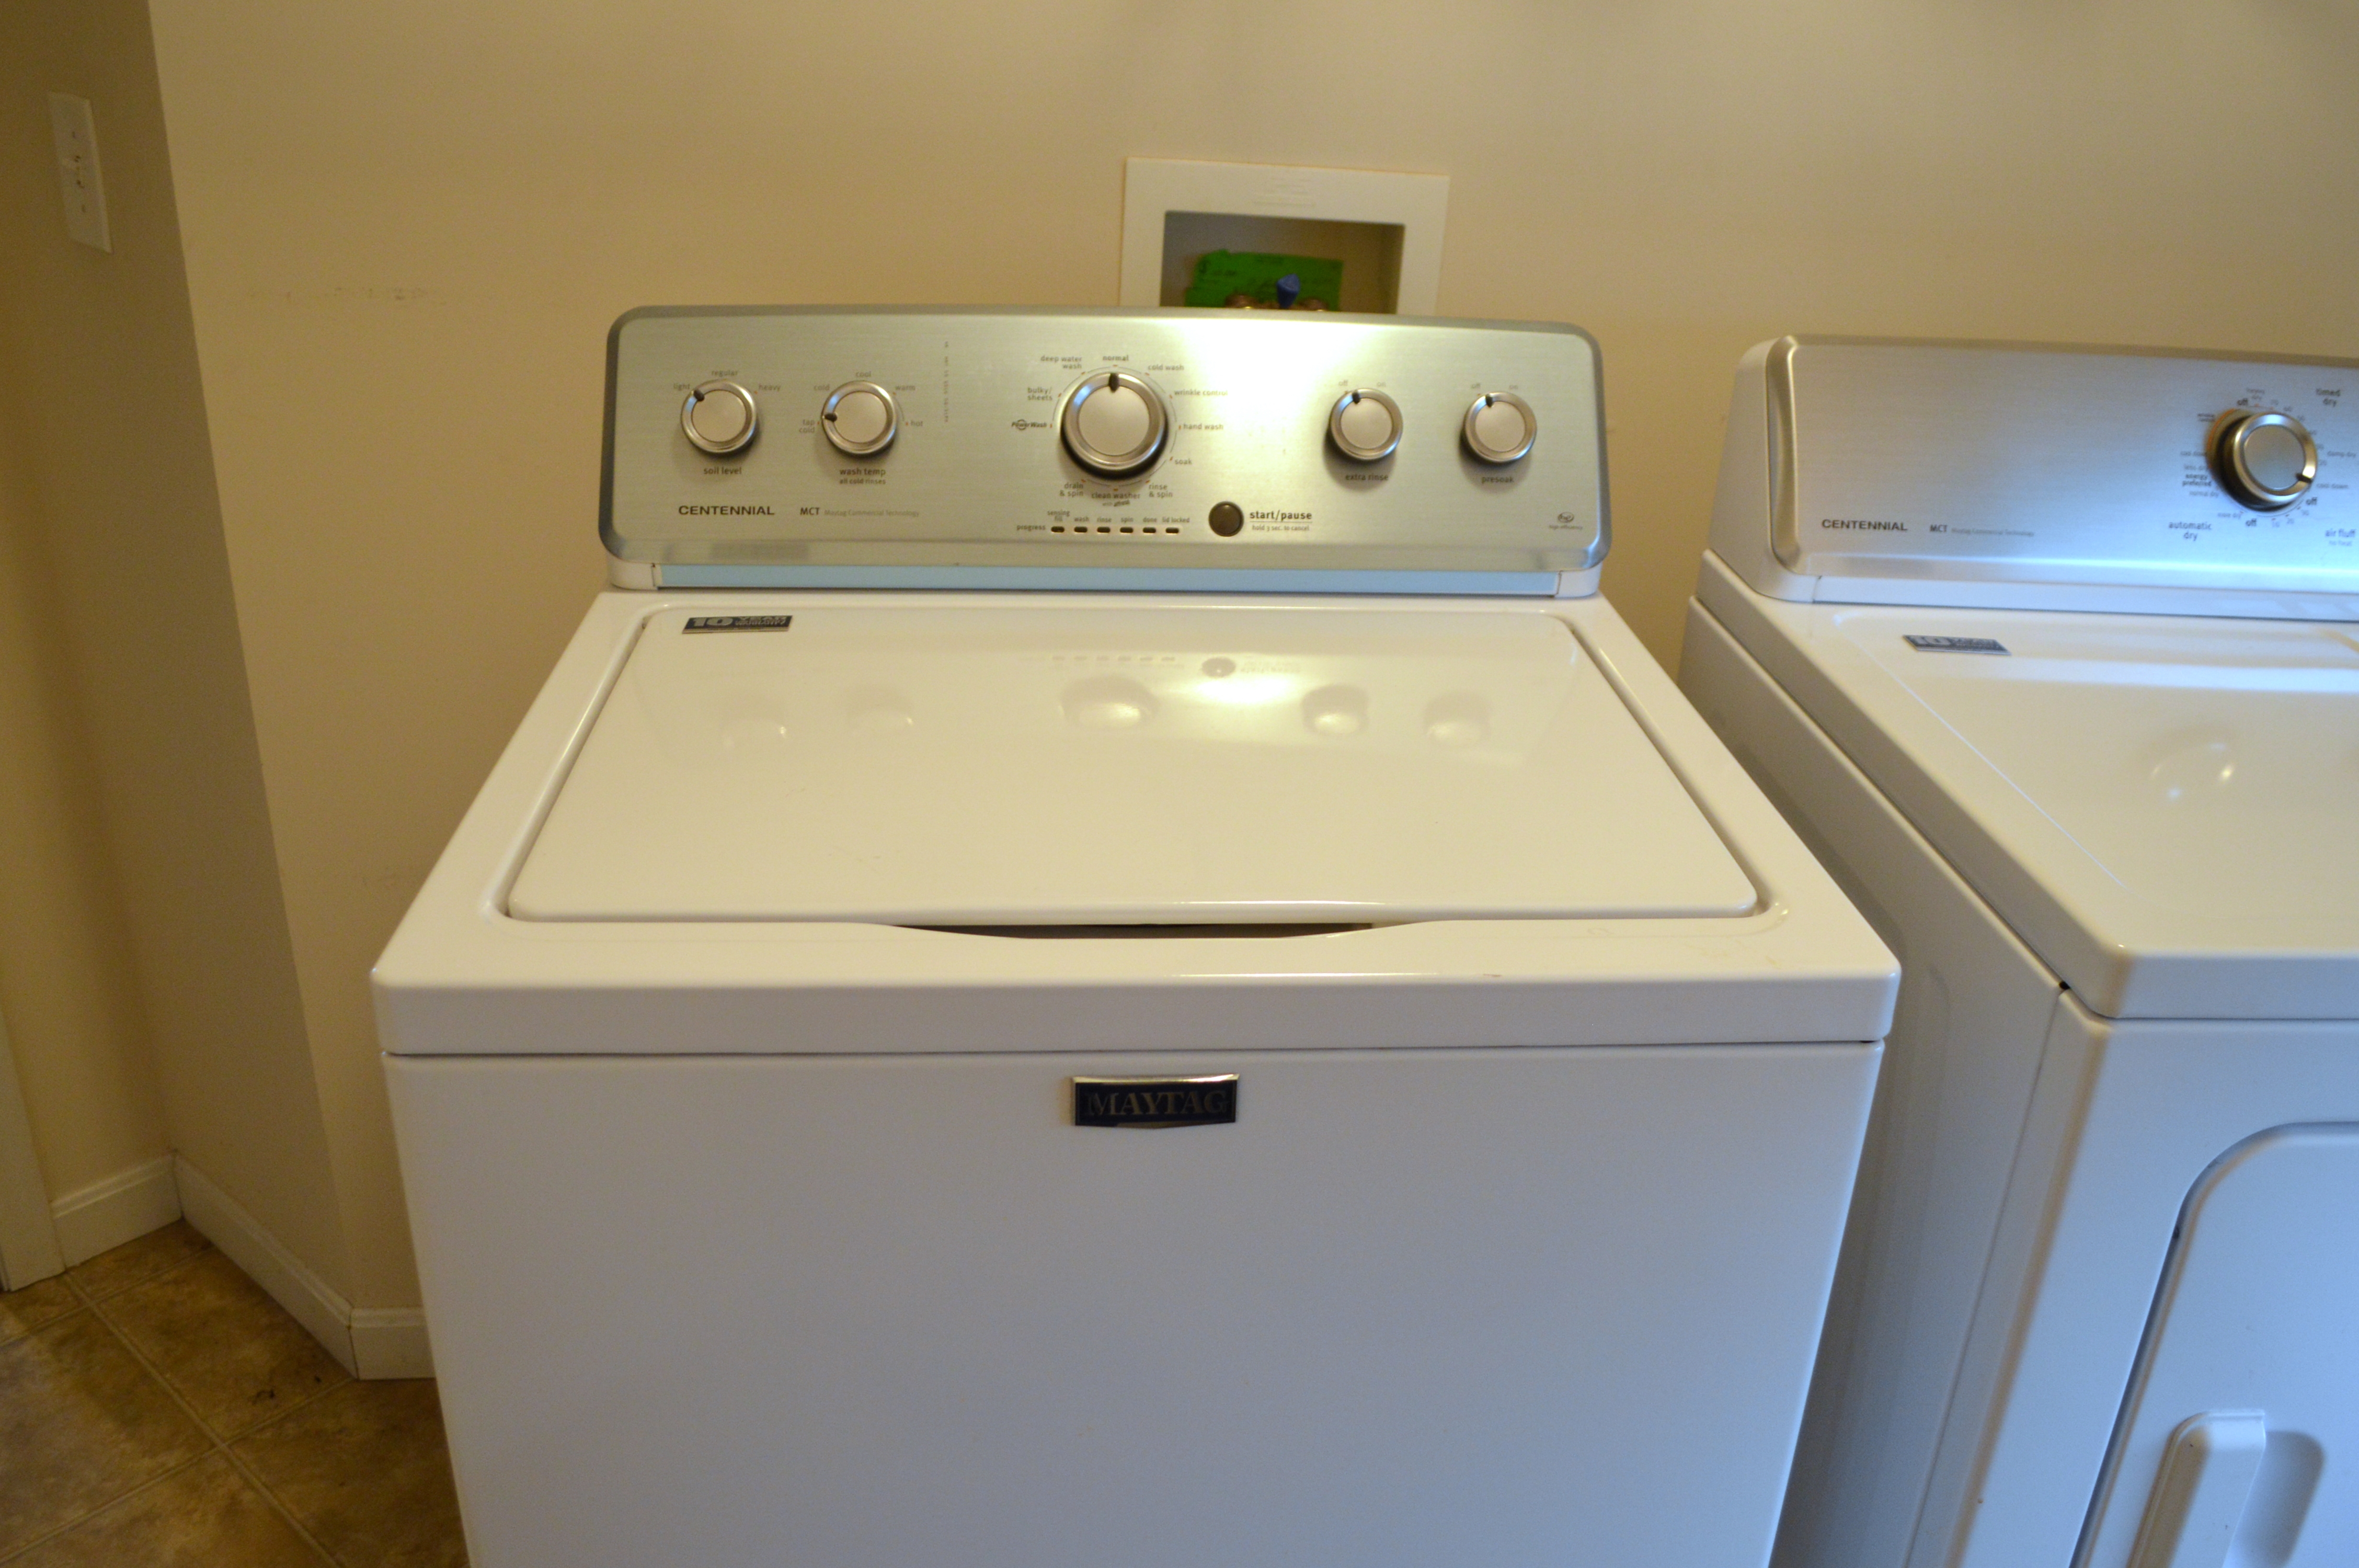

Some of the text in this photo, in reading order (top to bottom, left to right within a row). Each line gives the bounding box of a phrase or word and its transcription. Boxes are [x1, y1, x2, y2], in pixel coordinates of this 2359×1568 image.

[703, 466, 742, 475] soil level
[864, 468, 886, 477] temp
[678, 504, 775, 516] CENTENNIAL
[799, 507, 820, 516] MCT
[1250, 510, 1312, 522] start/pause
[1822, 518, 1908, 532] CENTENNIAL
[1929, 524, 1948, 533] MCT
[2183, 532, 2198, 541] dry
[693, 616, 734, 627] 10
[1085, 1090, 1229, 1116] MAYTAG
